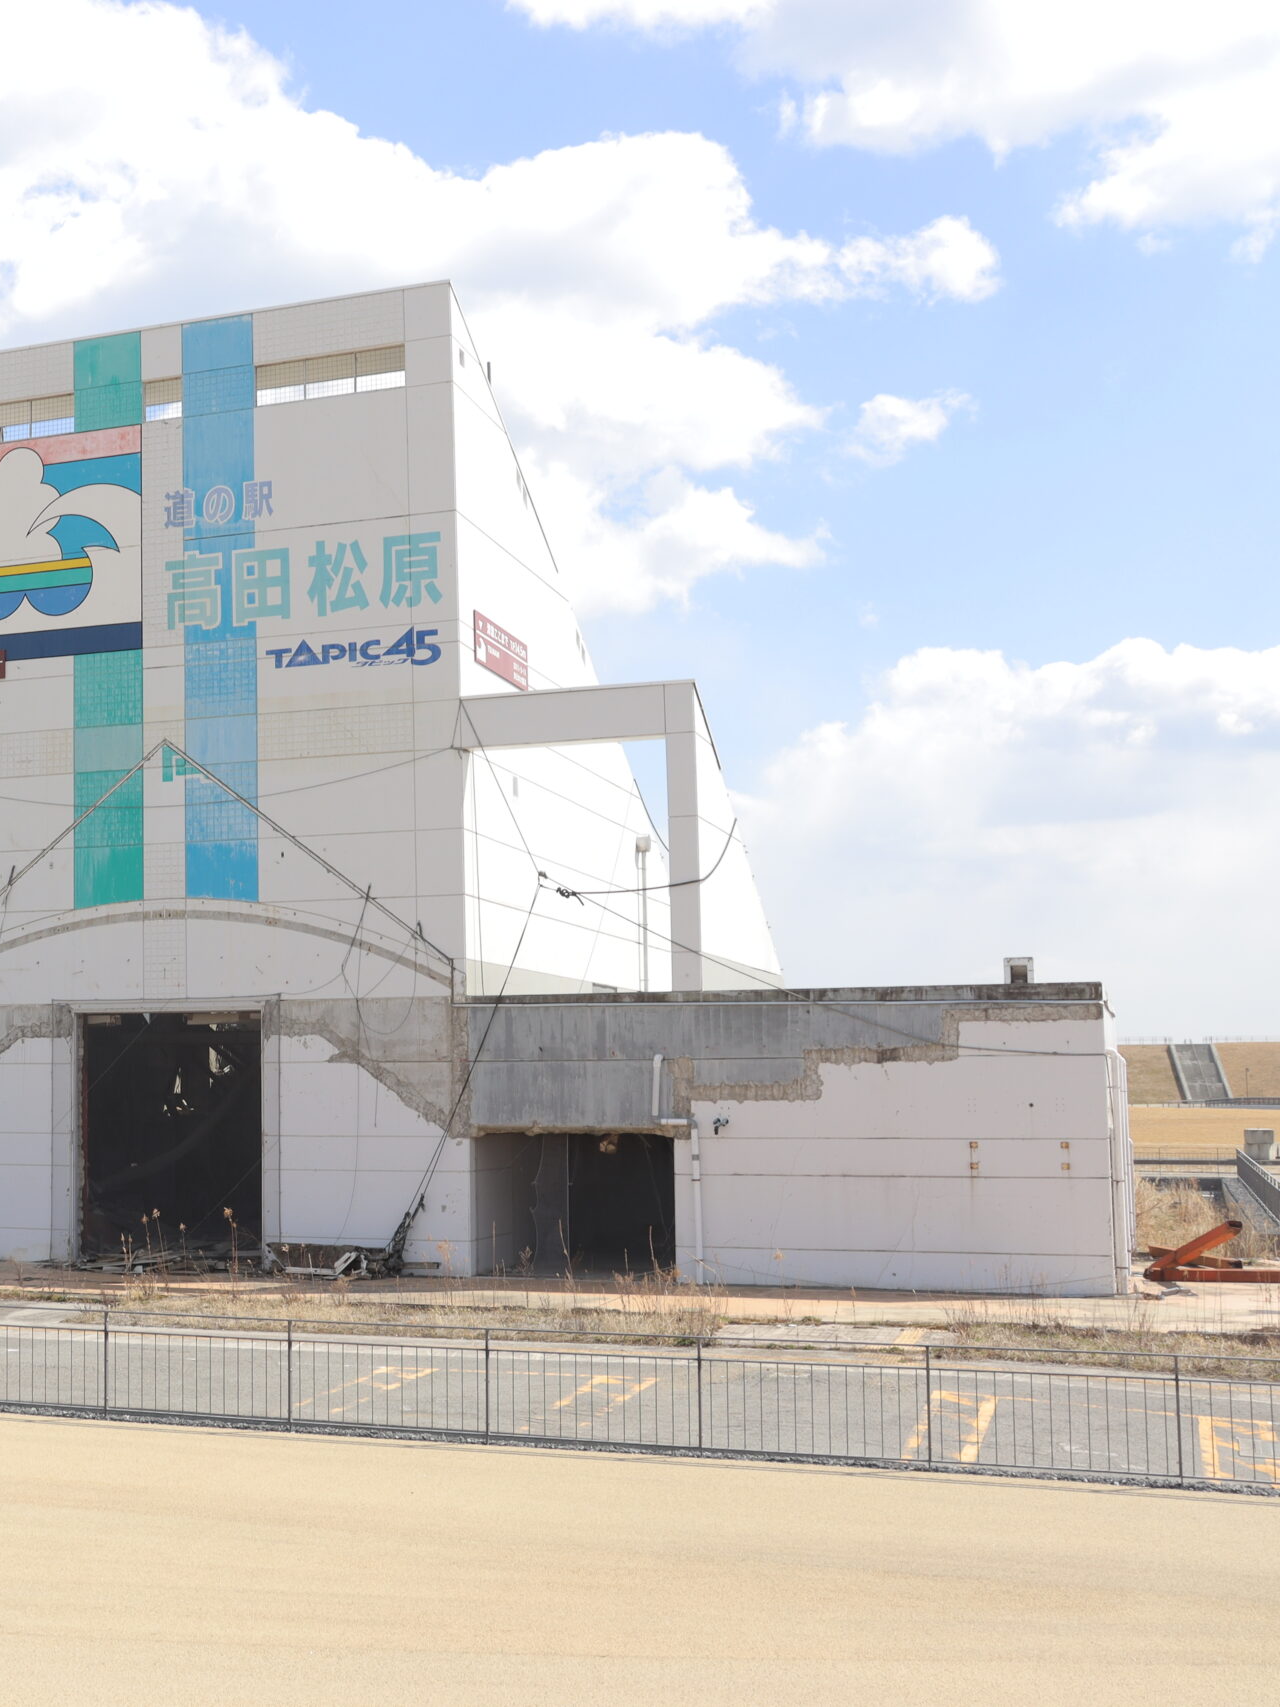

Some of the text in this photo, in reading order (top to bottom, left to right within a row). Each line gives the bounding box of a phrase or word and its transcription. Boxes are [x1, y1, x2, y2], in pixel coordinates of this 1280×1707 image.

[164, 480, 274, 530] 道の駅
[164, 531, 443, 630] 高田松原
[265, 626, 442, 669] TAPIC45
